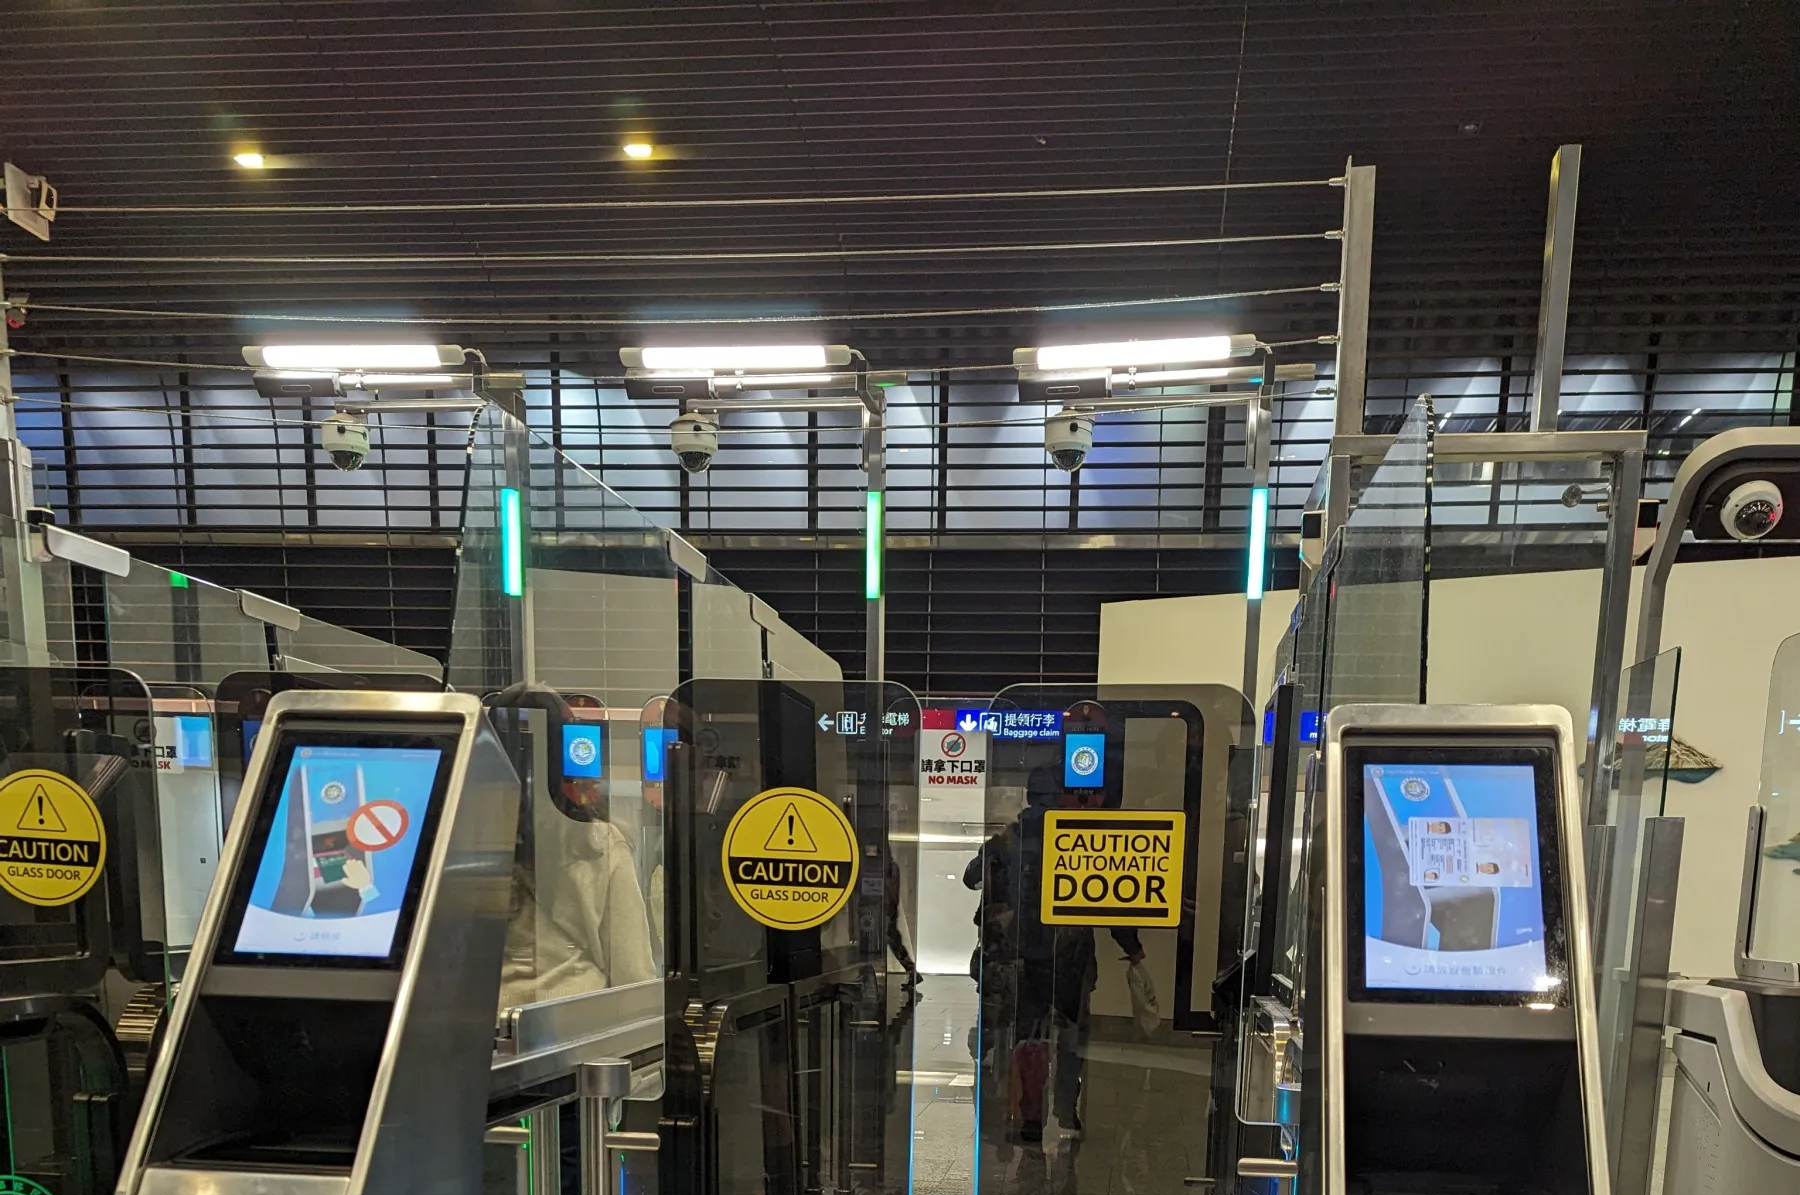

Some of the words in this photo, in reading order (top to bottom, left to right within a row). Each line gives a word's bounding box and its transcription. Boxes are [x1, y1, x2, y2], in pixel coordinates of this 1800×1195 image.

[1004, 712, 1055, 727] 提領行李
[1003, 727, 1038, 738] Baggage
[1039, 727, 1060, 737] claim
[921, 758, 986, 774] 請拿下口罩
[928, 775, 945, 785] NO
[946, 775, 978, 785] MASK
[1054, 833, 1171, 854] CAUTION
[1054, 855, 1170, 873] AUTOMATIC
[7, 865, 43, 879] GLASS
[46, 868, 81, 881] DOOR
[738, 861, 839, 884] CAUTION
[750, 888, 789, 901] GLASS
[792, 890, 829, 903] DOOR
[1053, 873, 1168, 904] DOOR
